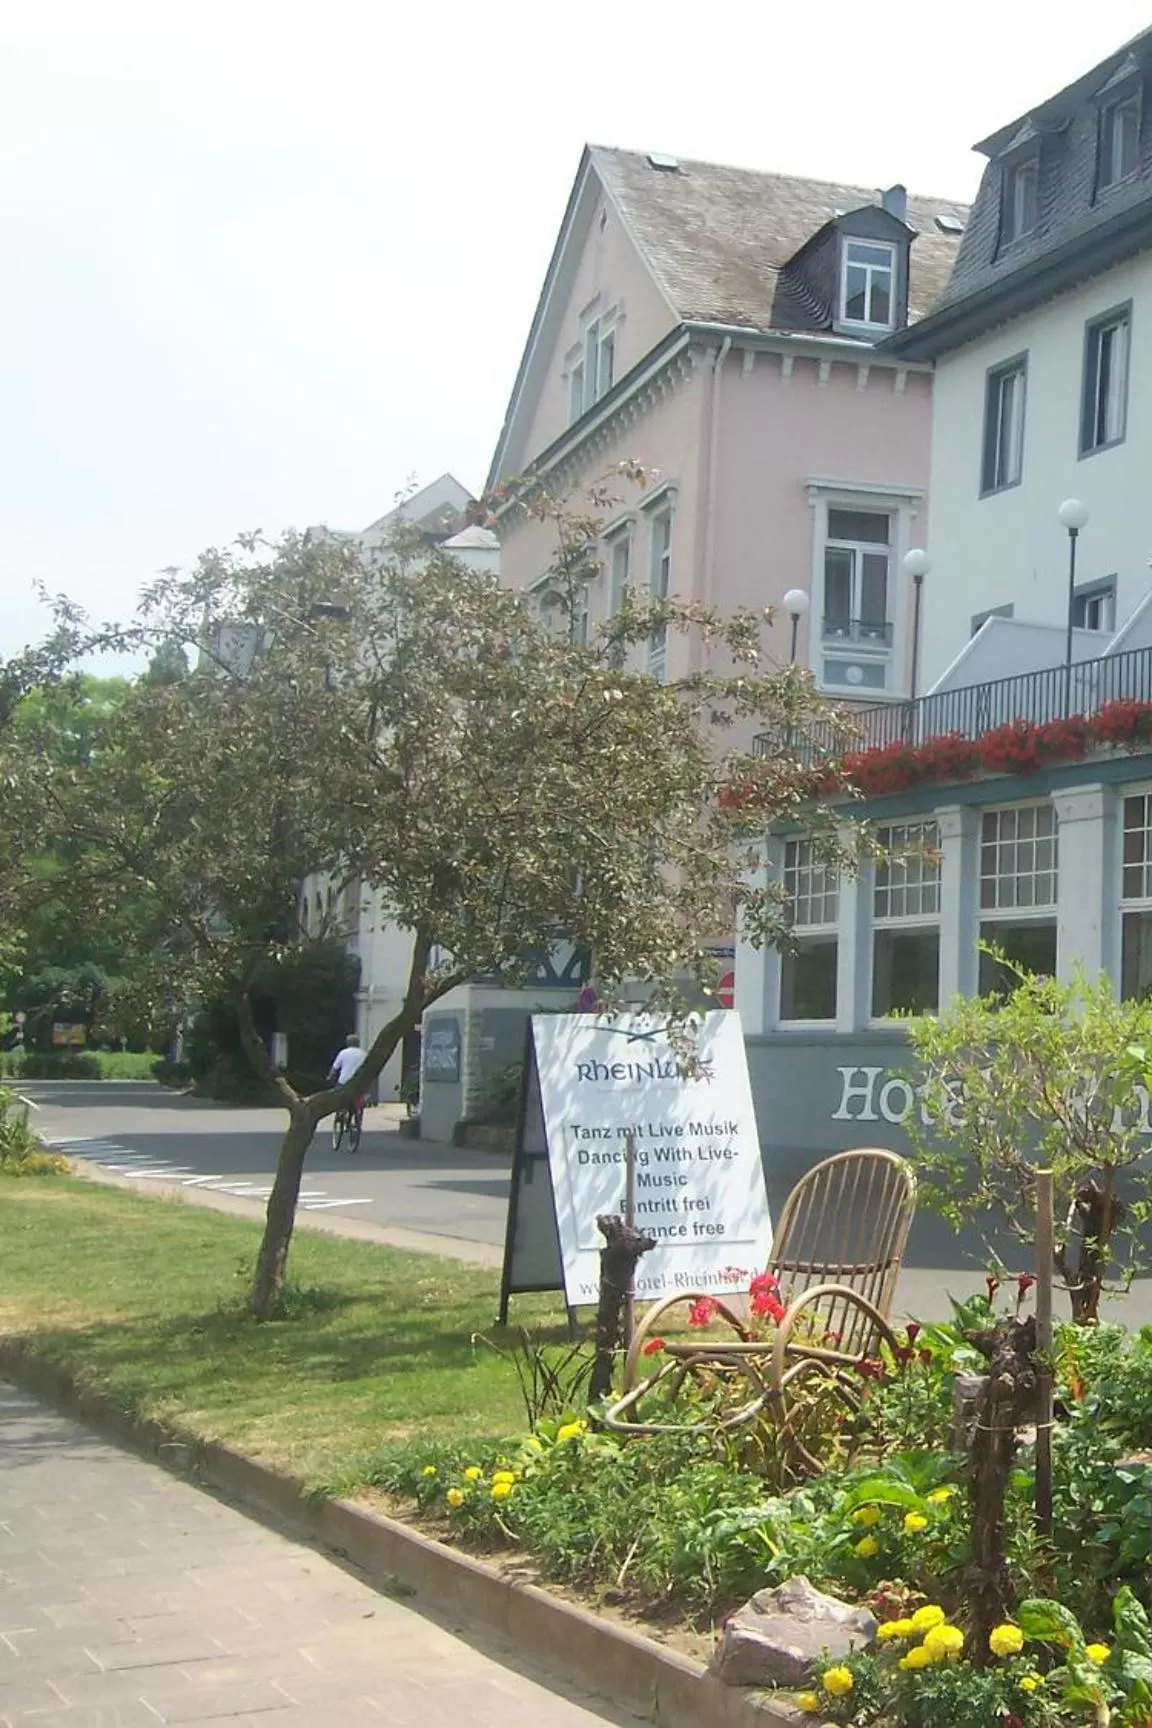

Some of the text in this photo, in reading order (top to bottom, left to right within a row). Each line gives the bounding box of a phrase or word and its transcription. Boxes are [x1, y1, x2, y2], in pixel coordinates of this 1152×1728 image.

[570, 1120, 739, 1140] Tanz mit Live Musik
[653, 1147, 692, 1163] With
[697, 1145, 740, 1162] Live-
[637, 1172, 688, 1189] Music
[619, 1195, 711, 1214] Entritt frei
[692, 1221, 726, 1236] free
